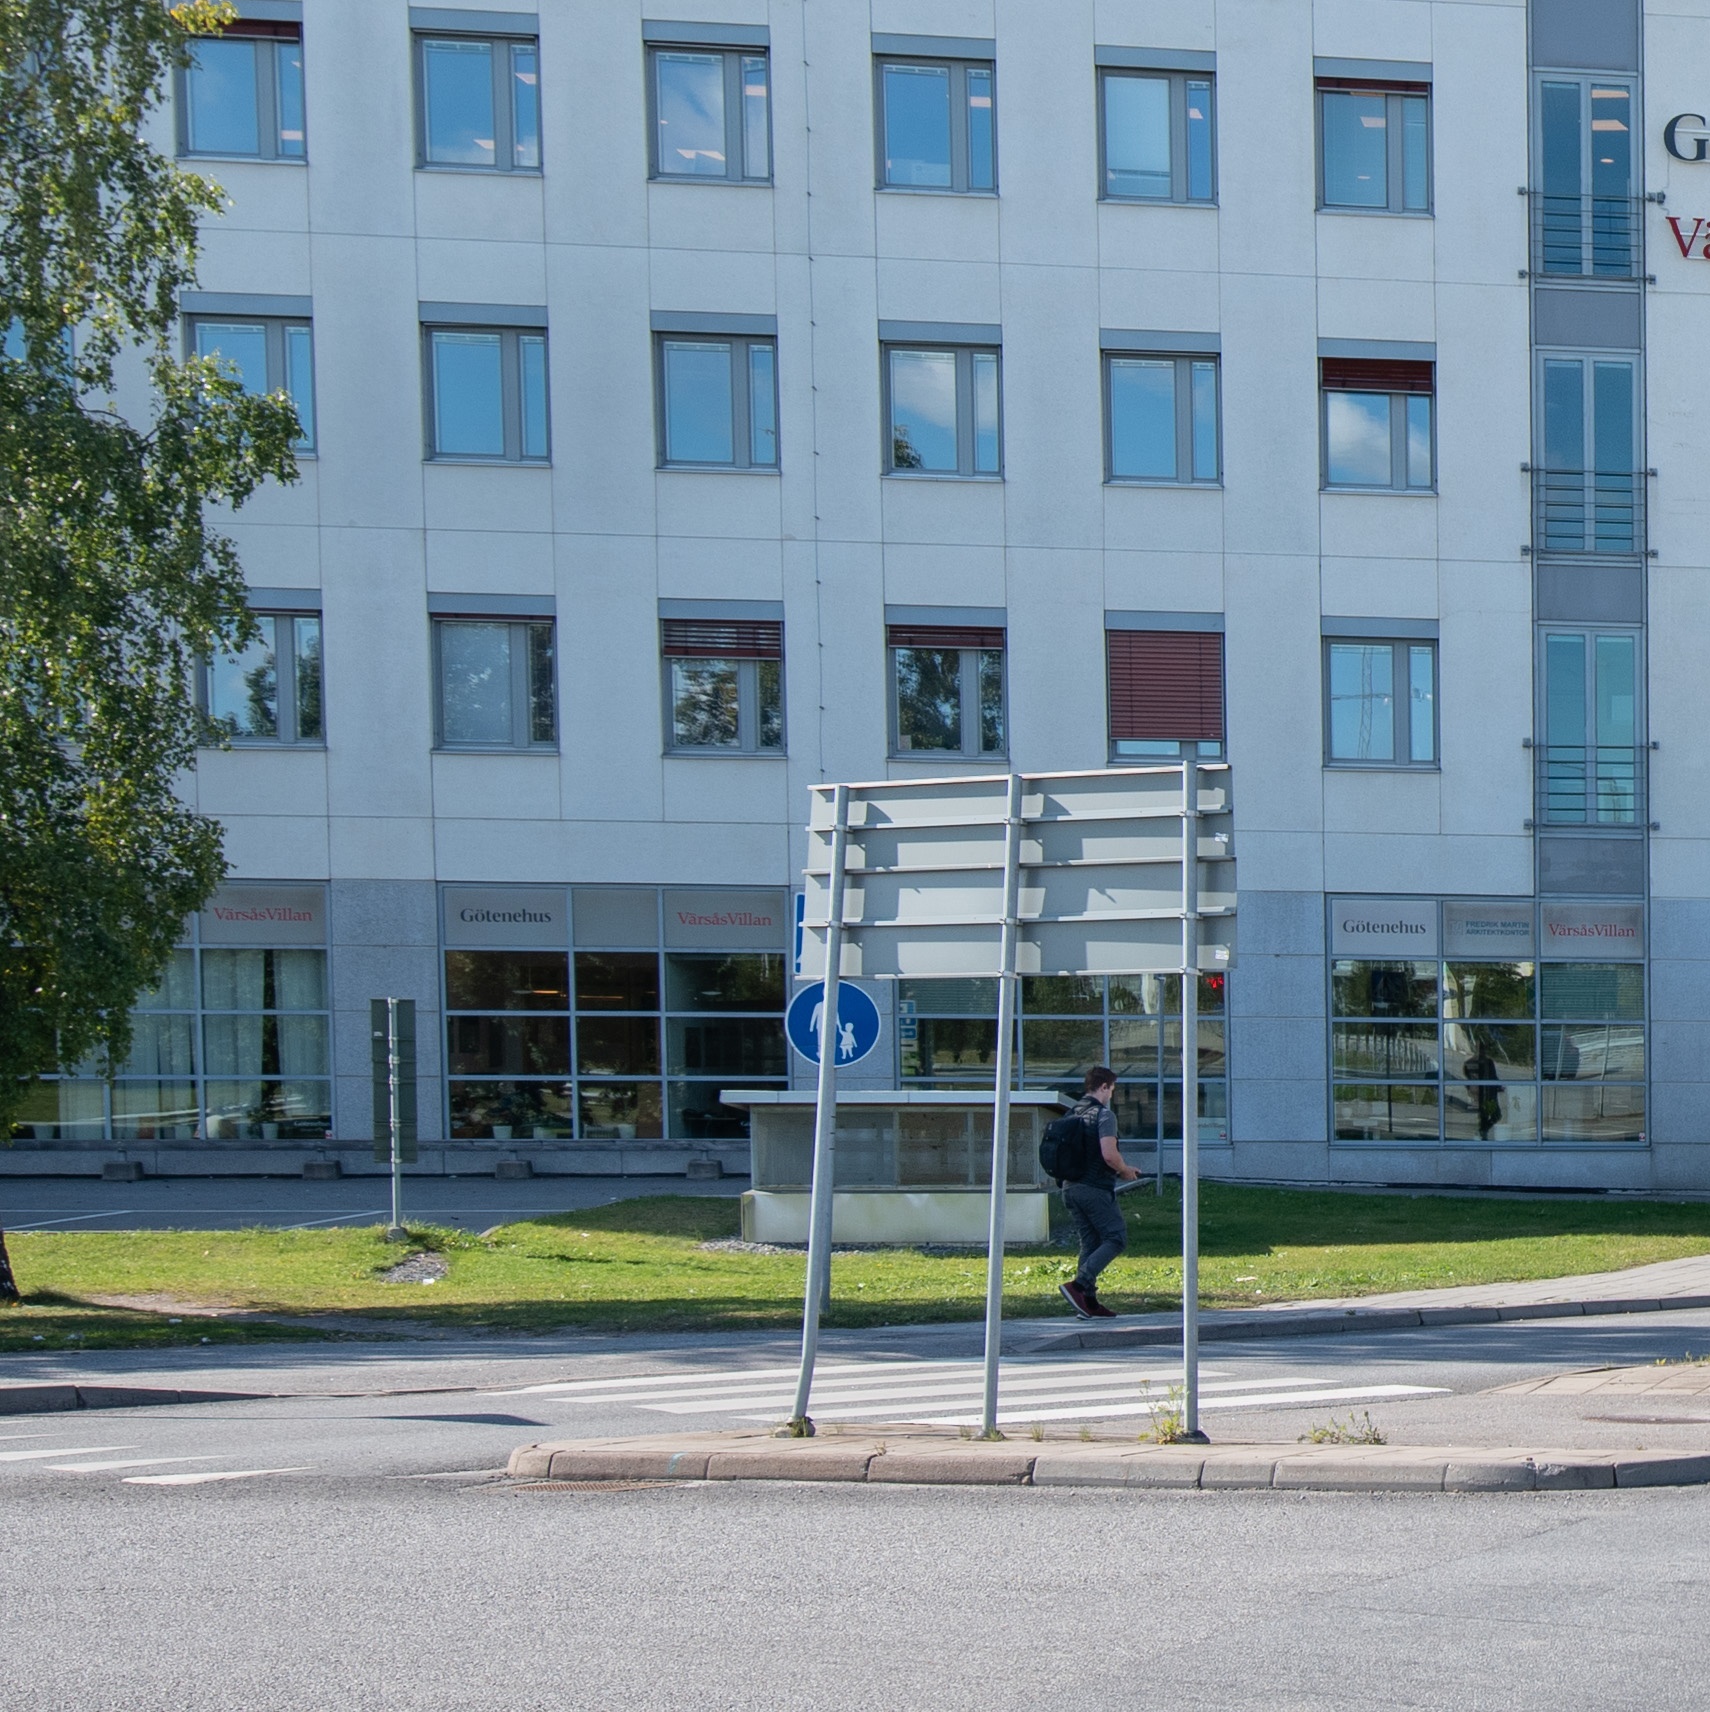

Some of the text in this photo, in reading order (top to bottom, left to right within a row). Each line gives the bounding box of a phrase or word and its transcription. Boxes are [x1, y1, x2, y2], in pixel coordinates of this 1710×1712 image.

[213, 906, 313, 922] VärsåsVillan
[459, 907, 552, 923] Götenehus
[677, 911, 772, 926] VärsåsVillan
[1342, 919, 1426, 935] Götenehus
[1465, 920, 1498, 928] FREDRIK
[1548, 923, 1636, 938] VärsåsVillan
